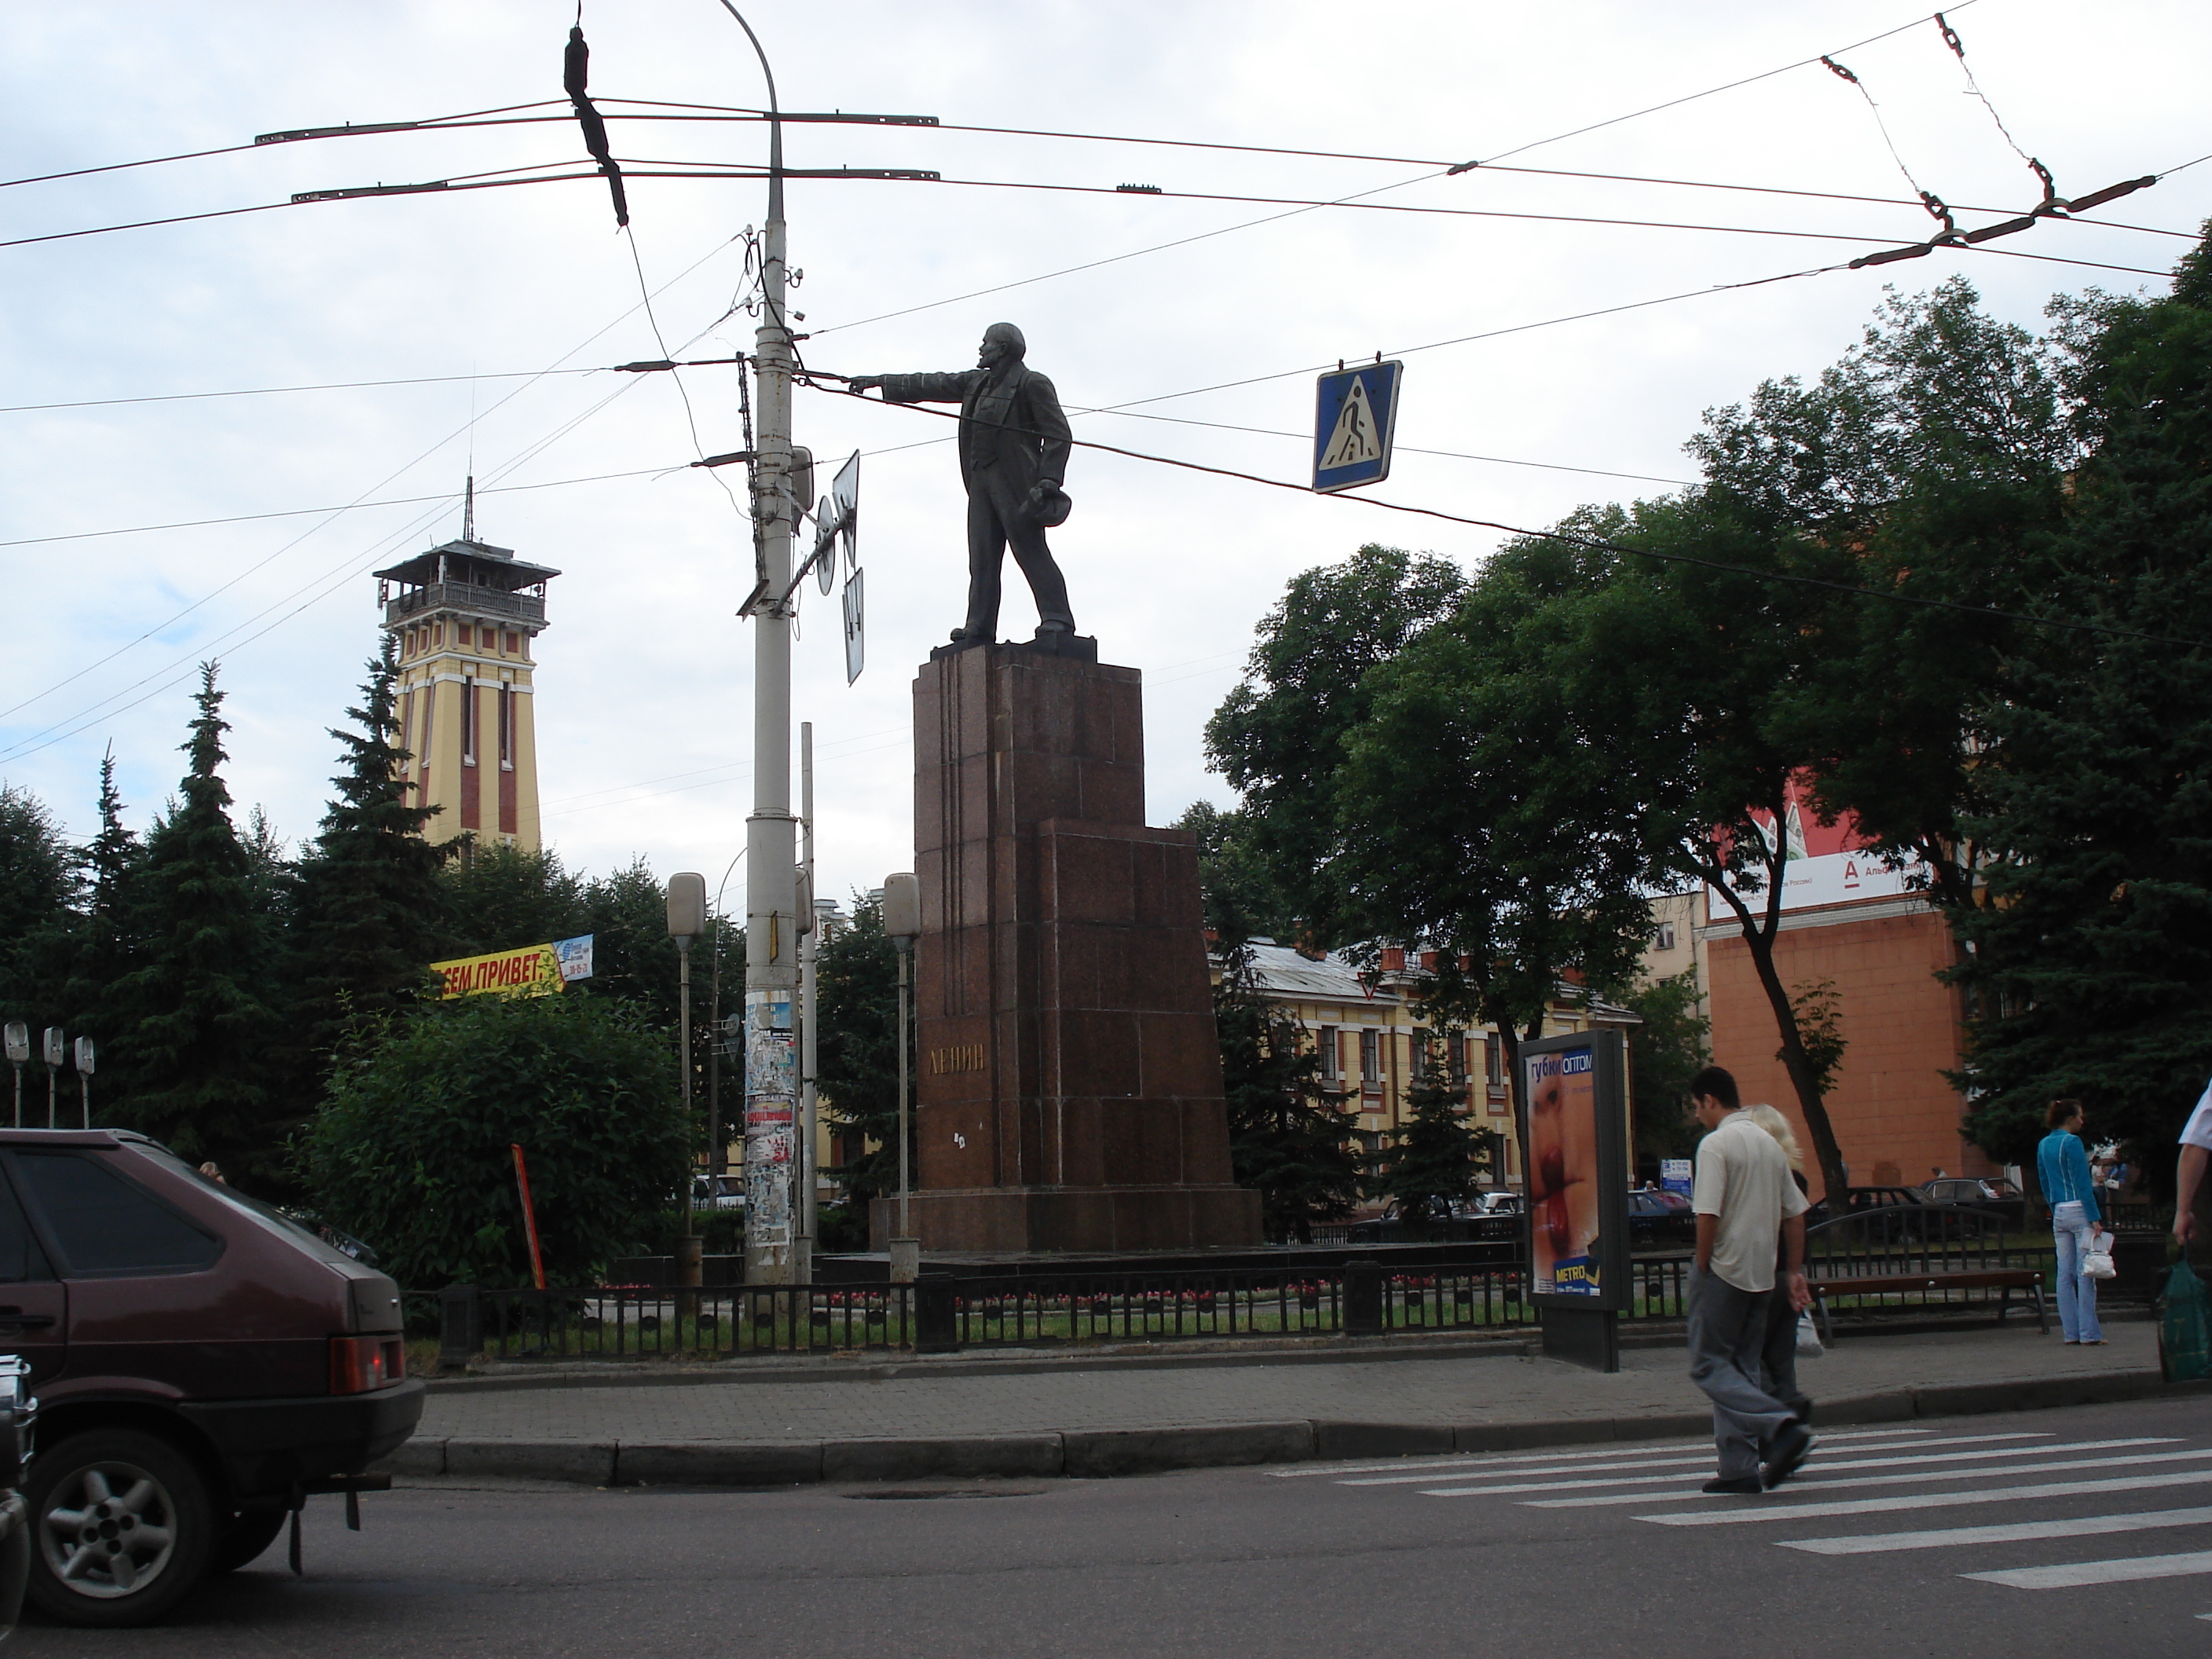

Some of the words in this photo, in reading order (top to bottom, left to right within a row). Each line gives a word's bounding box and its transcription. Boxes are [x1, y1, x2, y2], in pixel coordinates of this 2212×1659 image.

[434, 965, 472, 994] СЕМ
[928, 1044, 984, 1075] ЛЕНИН
[1556, 1265, 1586, 1284] METRO
